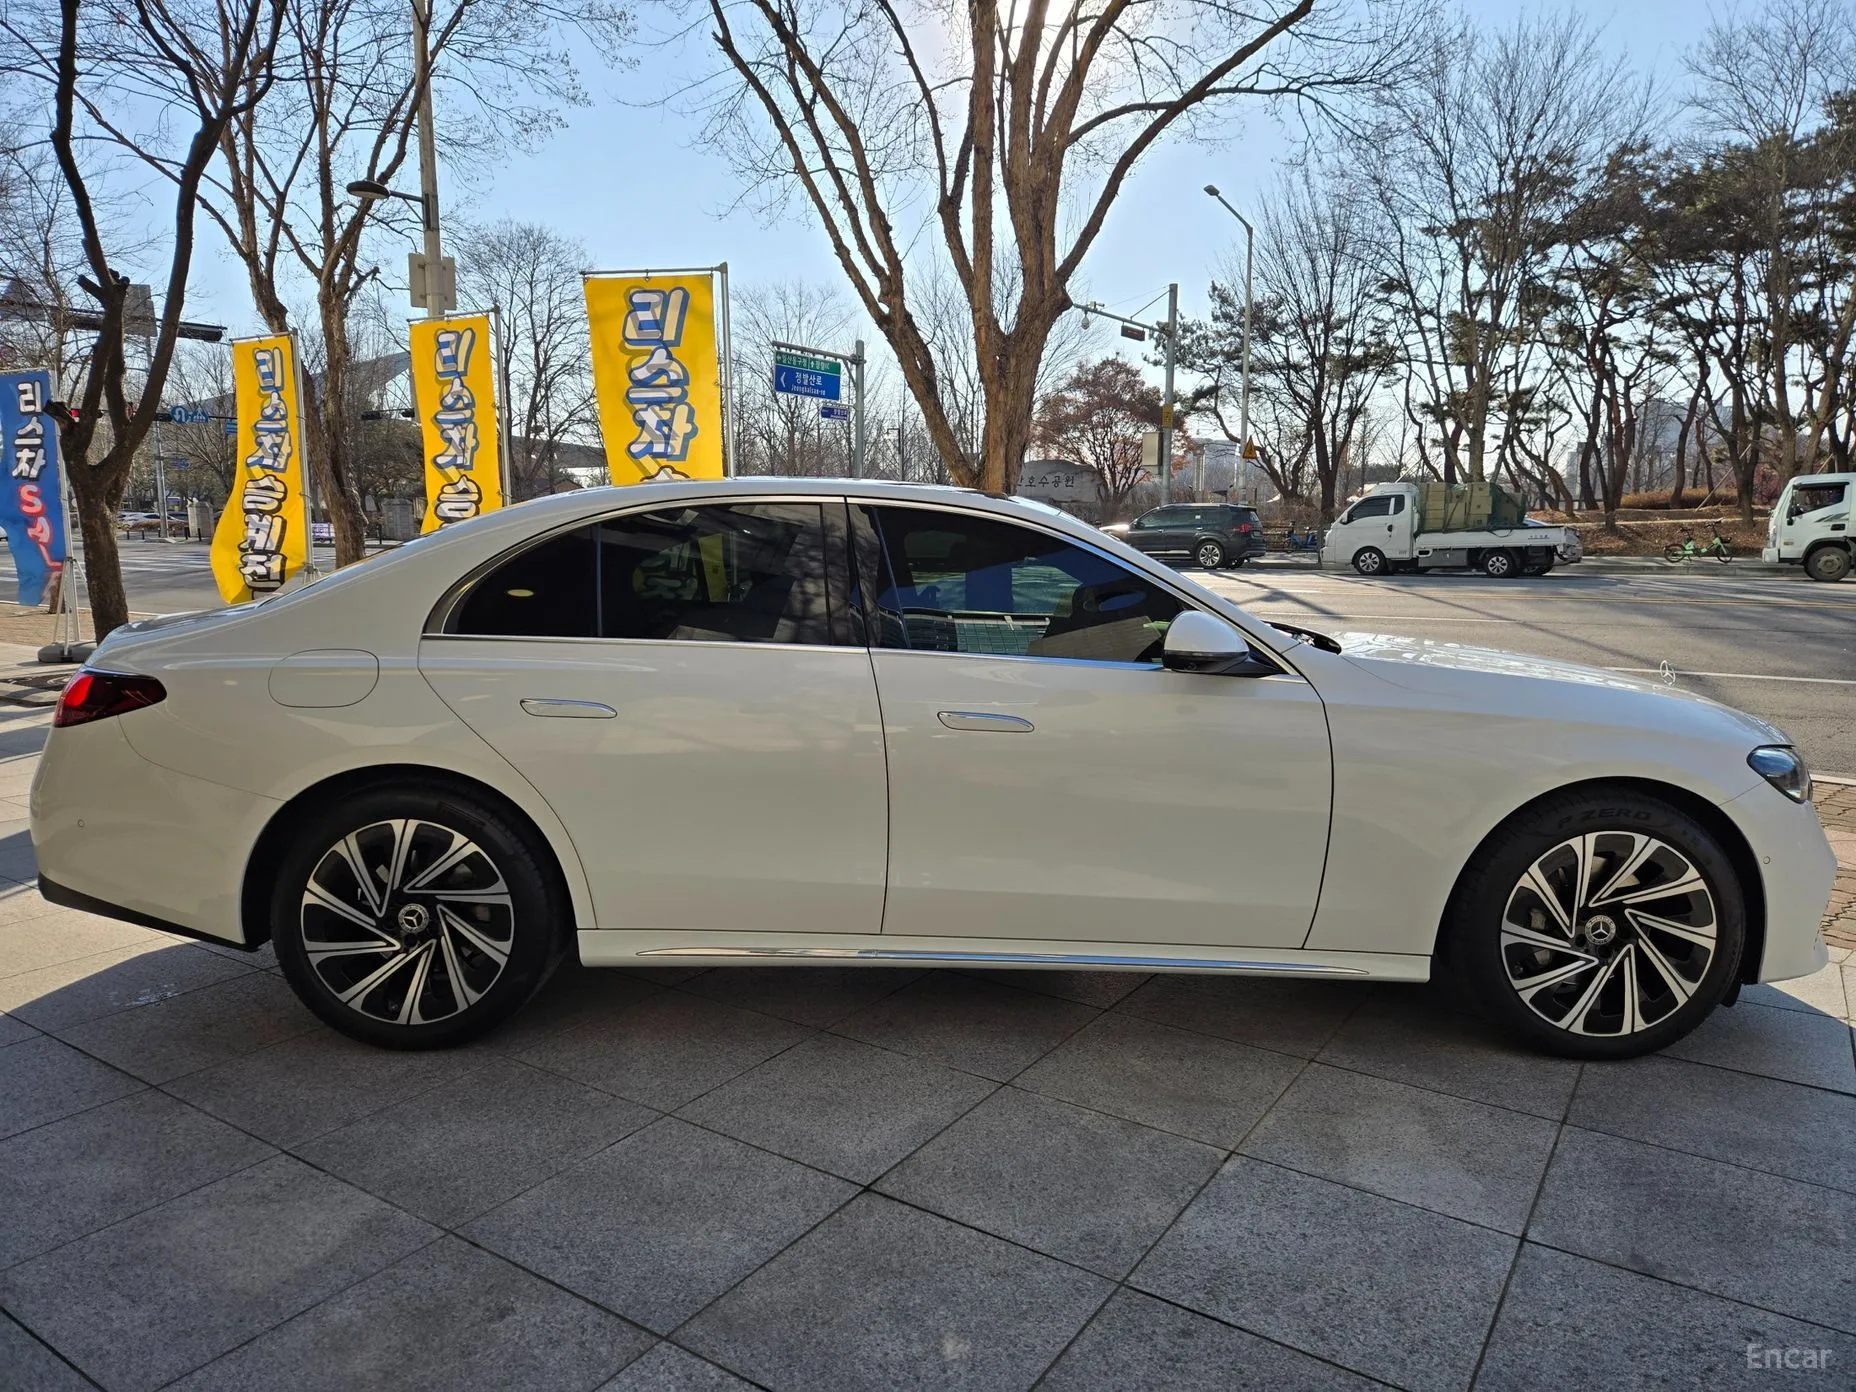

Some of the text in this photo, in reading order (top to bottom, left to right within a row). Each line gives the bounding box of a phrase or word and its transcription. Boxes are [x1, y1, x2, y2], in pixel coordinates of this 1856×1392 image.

[12, 381, 45, 478] 리스차
[246, 347, 292, 473] 리스차
[433, 328, 479, 470] 리스차
[622, 287, 698, 461] 리스차
[796, 372, 823, 386] 정발산로
[1581, 807, 1653, 820] ZERO
